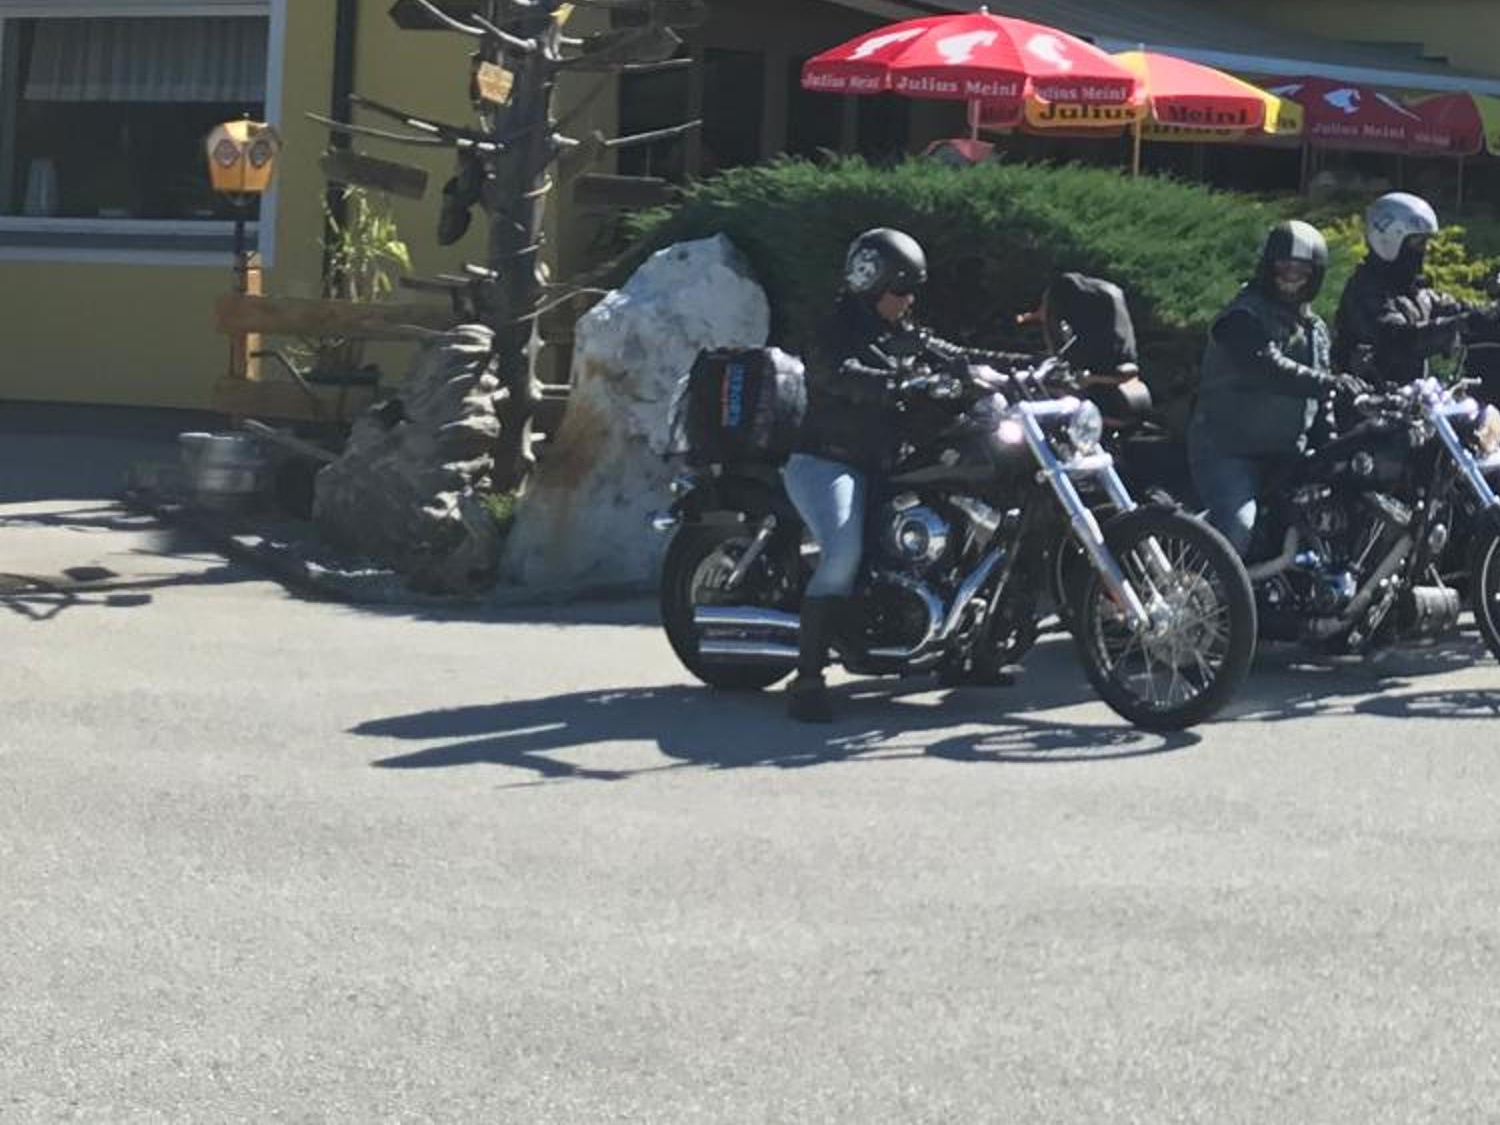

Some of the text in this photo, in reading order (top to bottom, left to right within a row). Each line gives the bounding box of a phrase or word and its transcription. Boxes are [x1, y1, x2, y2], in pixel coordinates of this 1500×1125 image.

[896, 75, 1017, 96] Julius Meinl
[1168, 105, 1247, 124] Meinl
